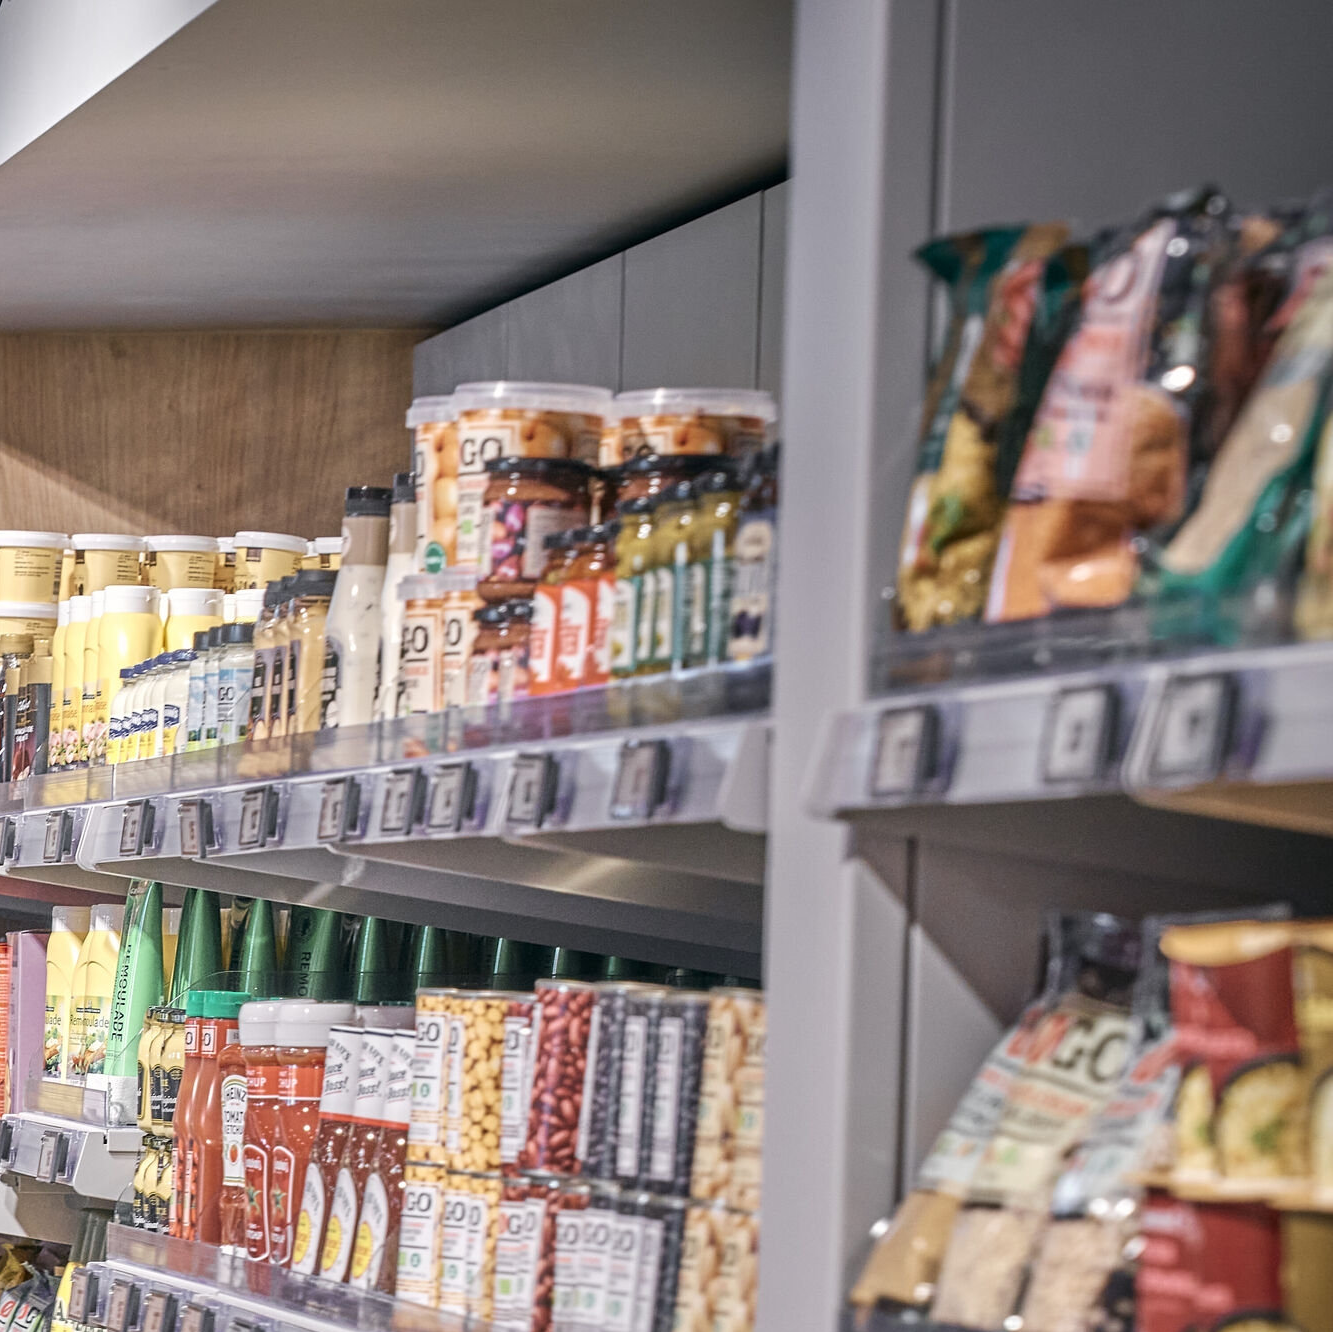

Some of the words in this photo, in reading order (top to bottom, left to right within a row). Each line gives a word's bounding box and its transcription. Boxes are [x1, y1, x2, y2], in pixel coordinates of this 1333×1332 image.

[461, 437, 504, 467] GO
[417, 1021, 441, 1043] GO
[406, 1190, 432, 1214] GO
